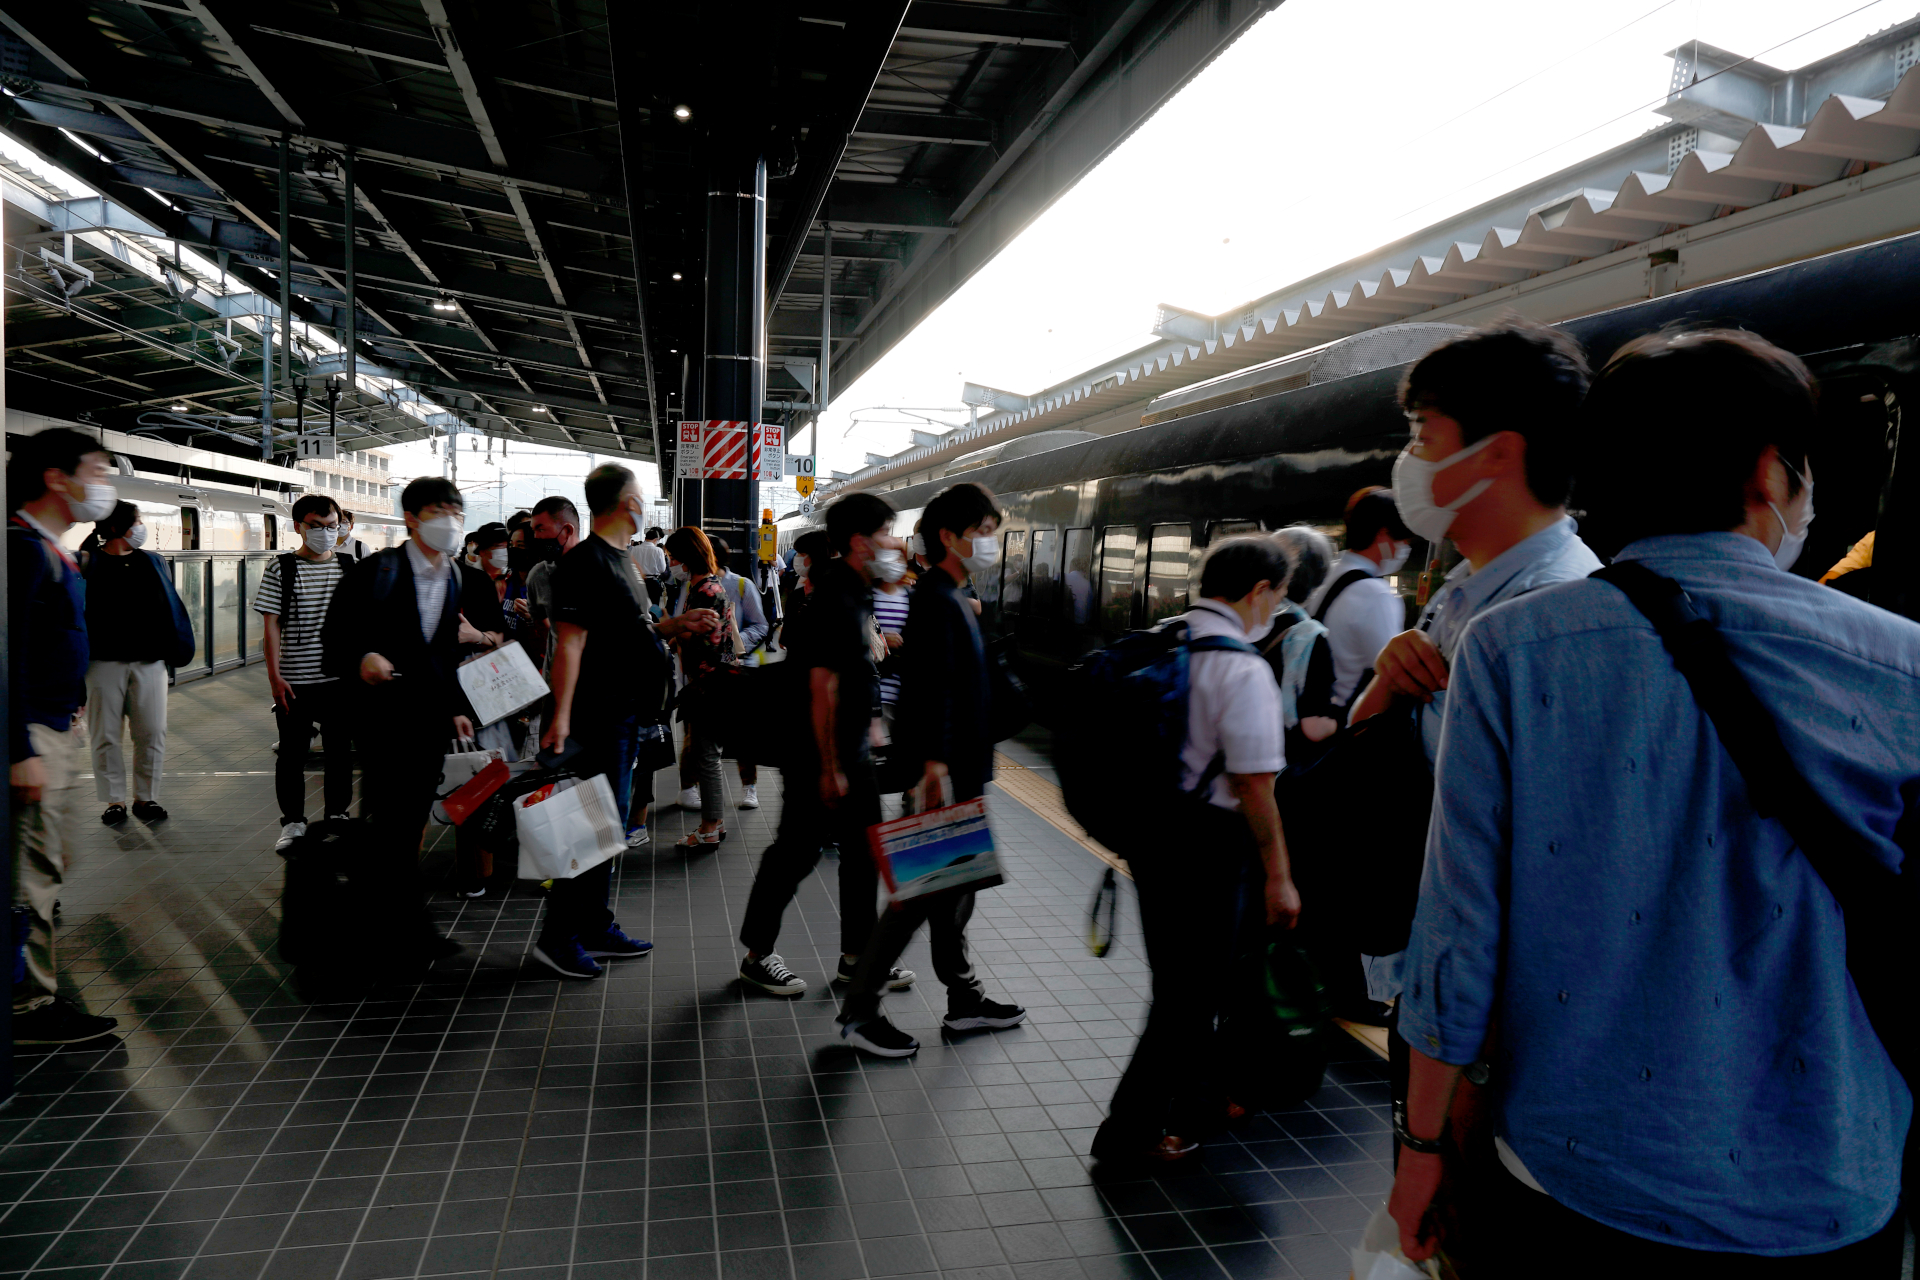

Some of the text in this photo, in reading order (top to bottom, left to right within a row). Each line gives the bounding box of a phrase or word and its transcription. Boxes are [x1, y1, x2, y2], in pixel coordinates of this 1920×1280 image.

[300, 439, 320, 455] 11
[794, 458, 813, 473] 10
[802, 485, 808, 494] 4
[803, 504, 810, 513] 6
